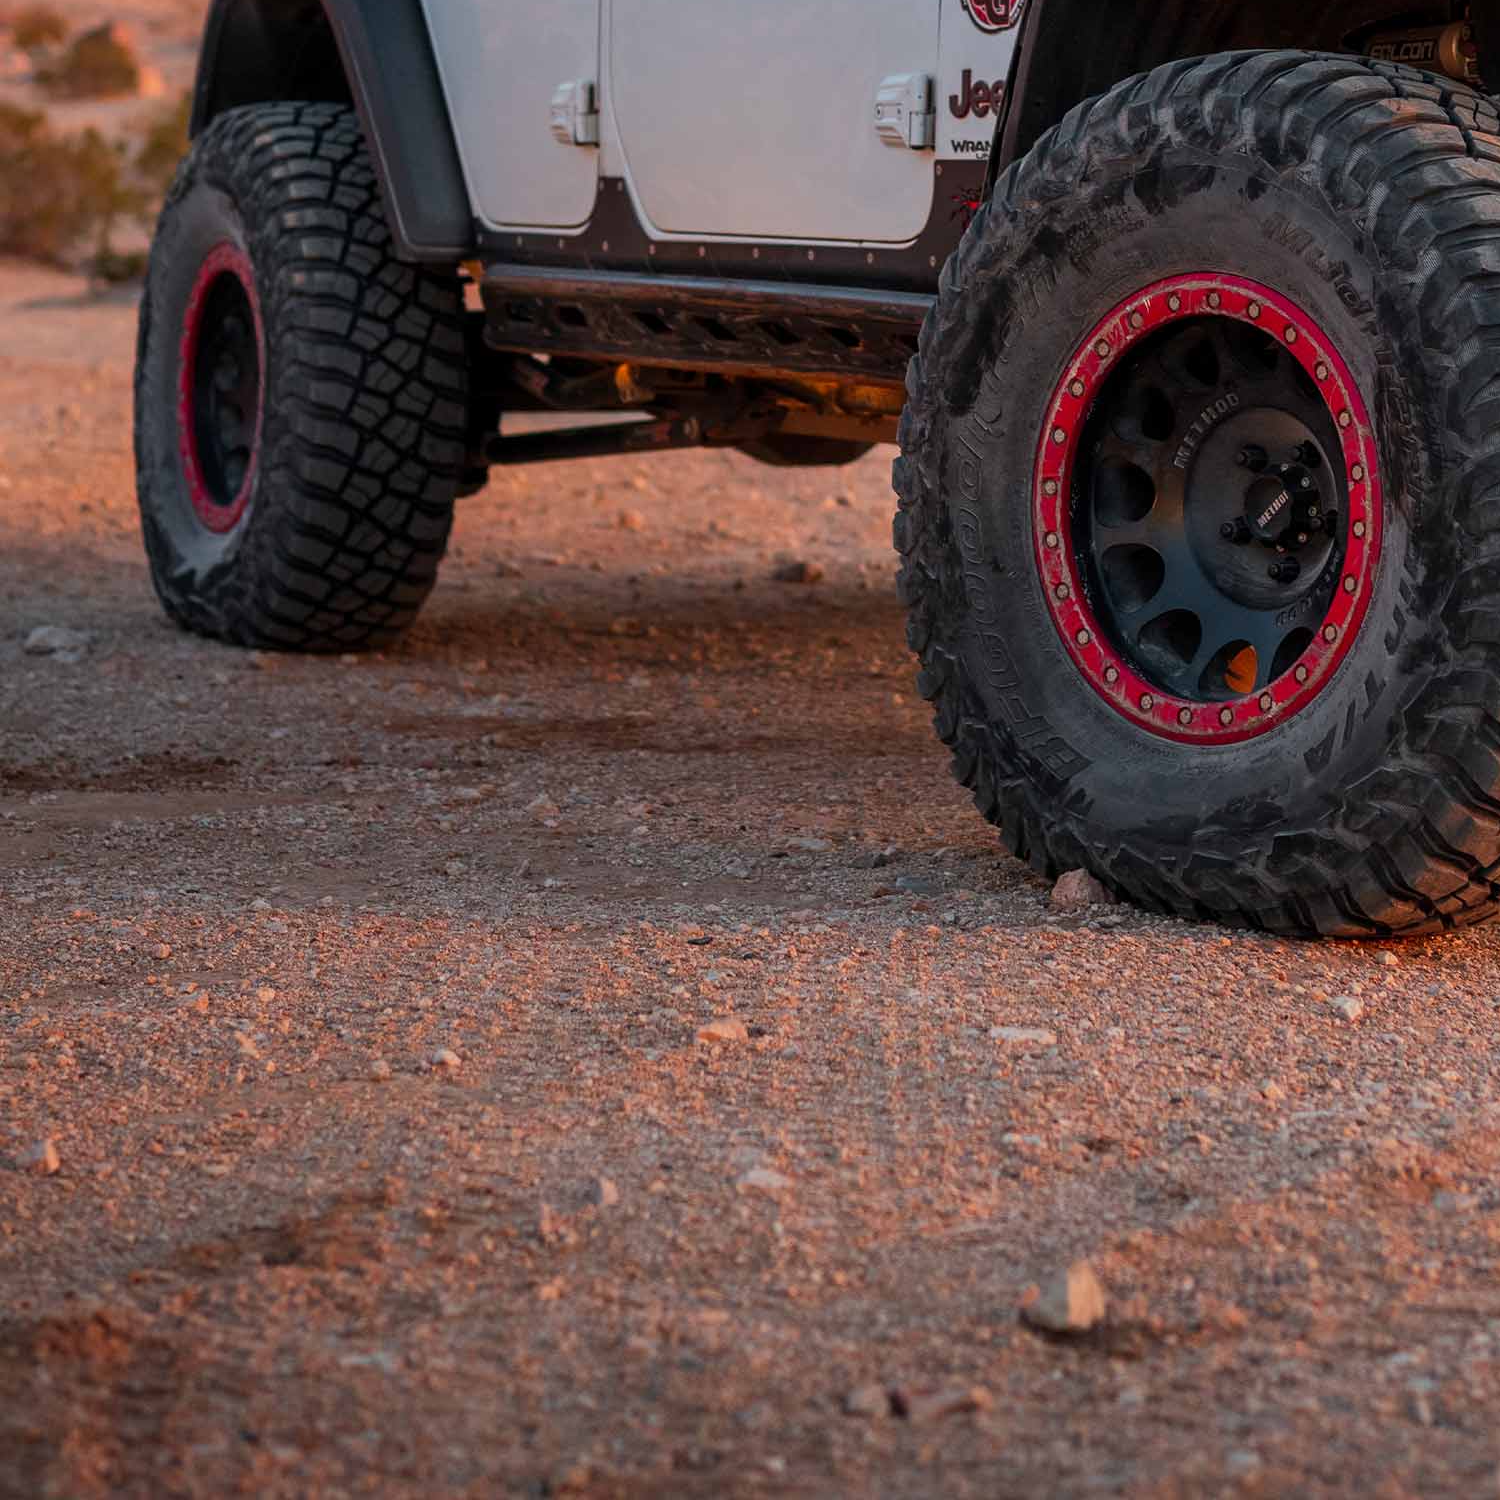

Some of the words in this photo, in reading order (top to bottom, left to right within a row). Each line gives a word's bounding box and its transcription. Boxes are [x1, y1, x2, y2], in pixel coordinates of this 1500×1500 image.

[949, 68, 1006, 118] Jee
[951, 140, 993, 153] WRAN
[1173, 391, 1241, 468] METHOD
